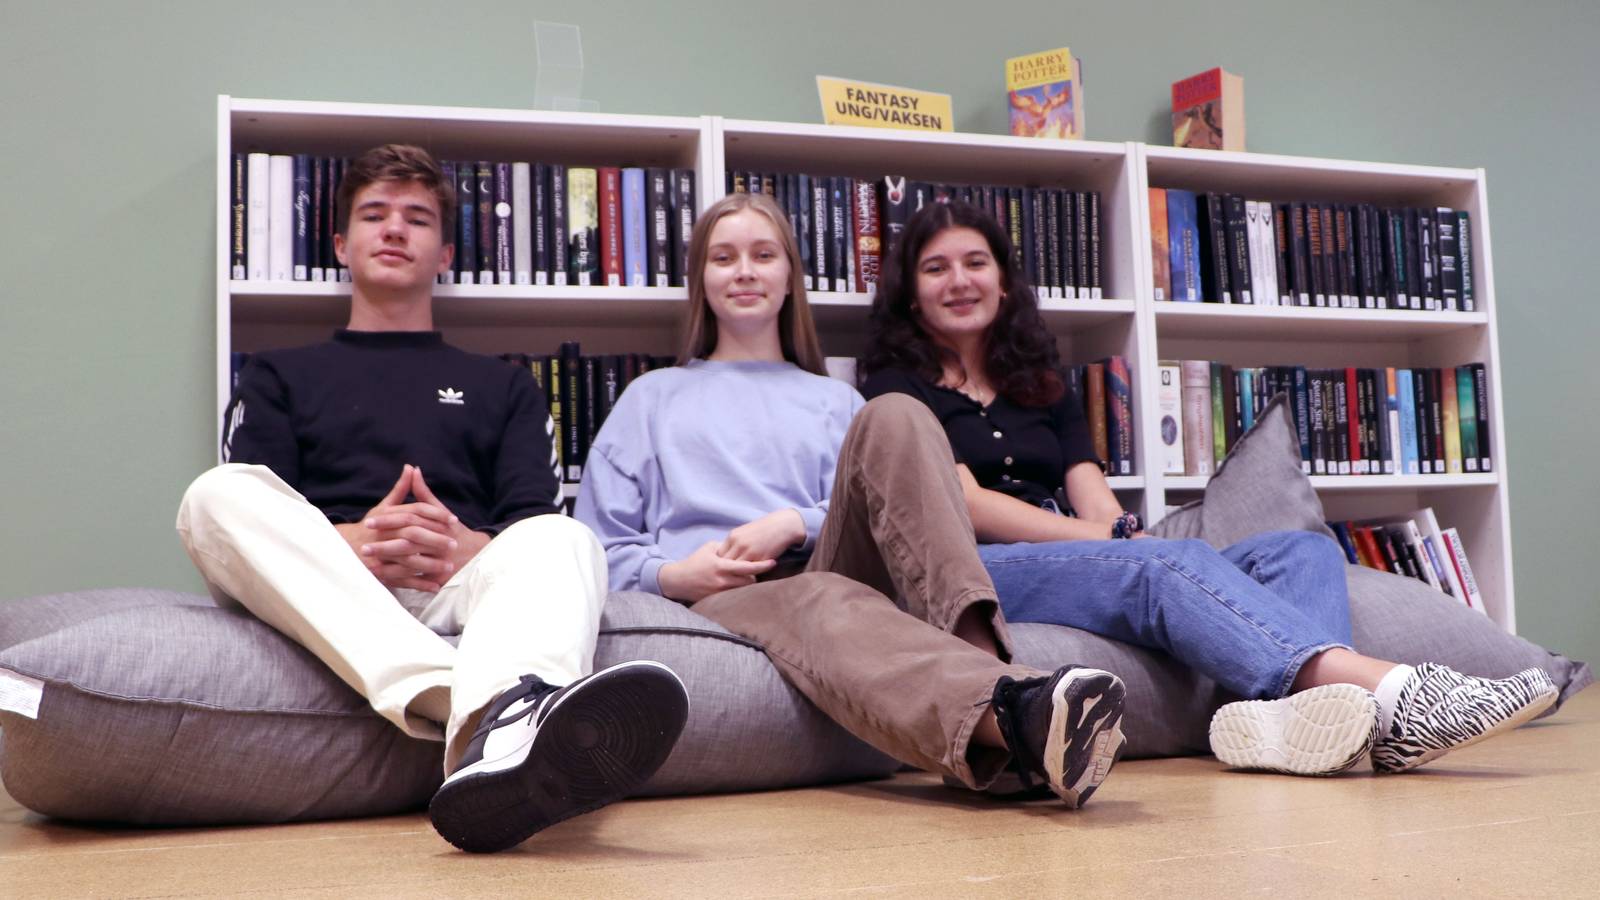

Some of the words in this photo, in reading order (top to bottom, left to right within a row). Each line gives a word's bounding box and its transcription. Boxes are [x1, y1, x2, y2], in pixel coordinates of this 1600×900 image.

[1013, 53, 1064, 71] HARRY
[1013, 63, 1067, 82] POTTER
[846, 87, 919, 111] FANTASY
[835, 101, 942, 129] UNG/VAKSEN
